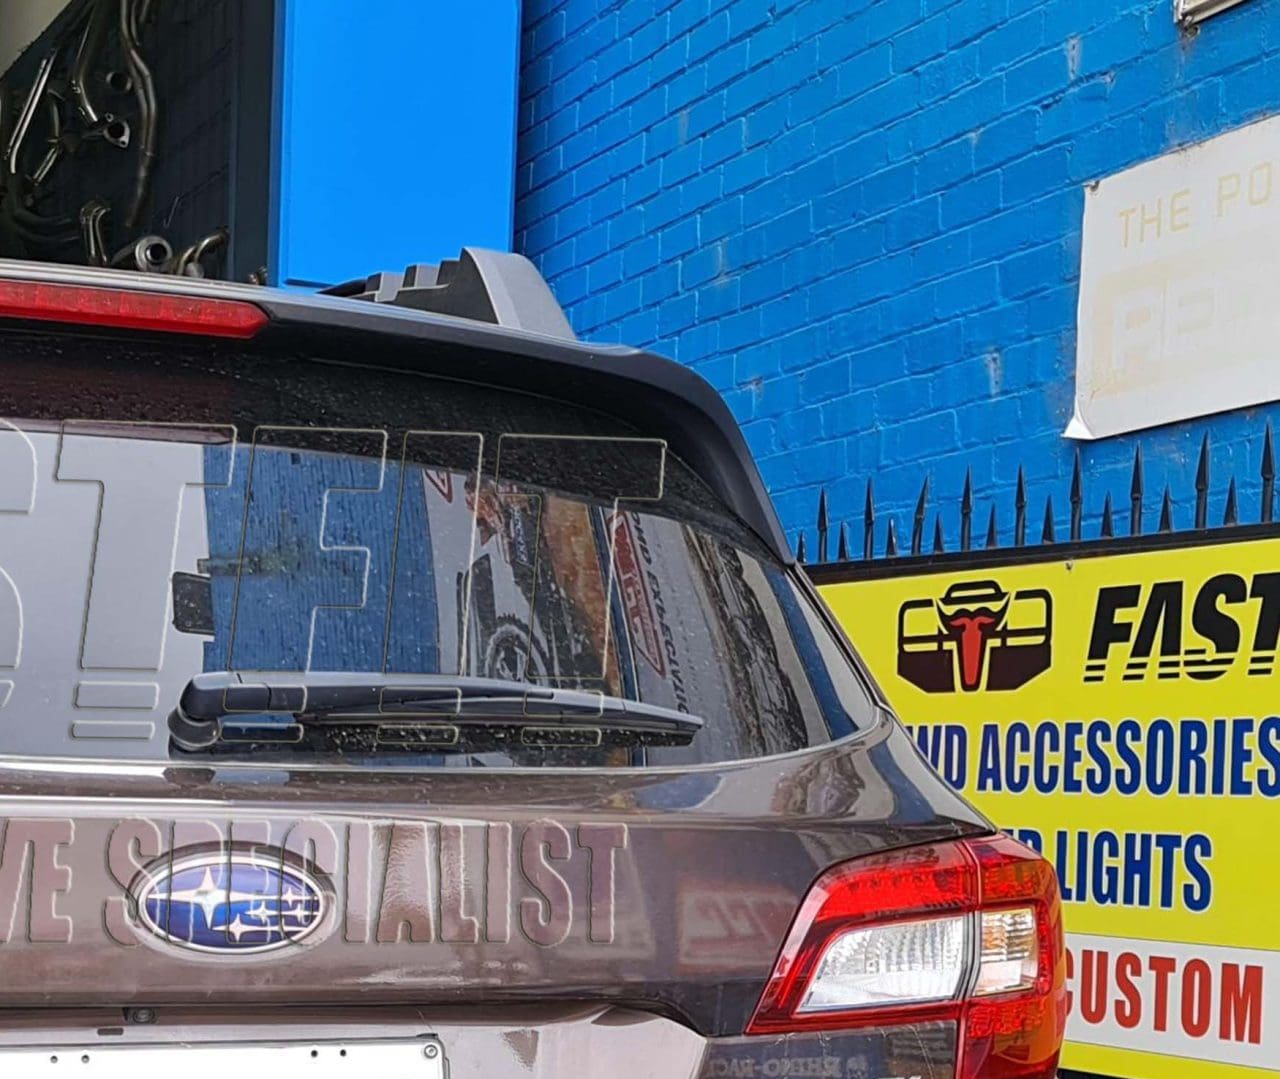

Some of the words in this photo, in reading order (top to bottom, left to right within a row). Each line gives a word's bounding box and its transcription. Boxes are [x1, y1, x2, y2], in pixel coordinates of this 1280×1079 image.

[1119, 187, 1191, 248] THE
[1083, 571, 1280, 683] FAST
[907, 724, 968, 790] WD
[976, 718, 1280, 798] ACCESSORIES
[1056, 830, 1212, 912] LIGHTS
